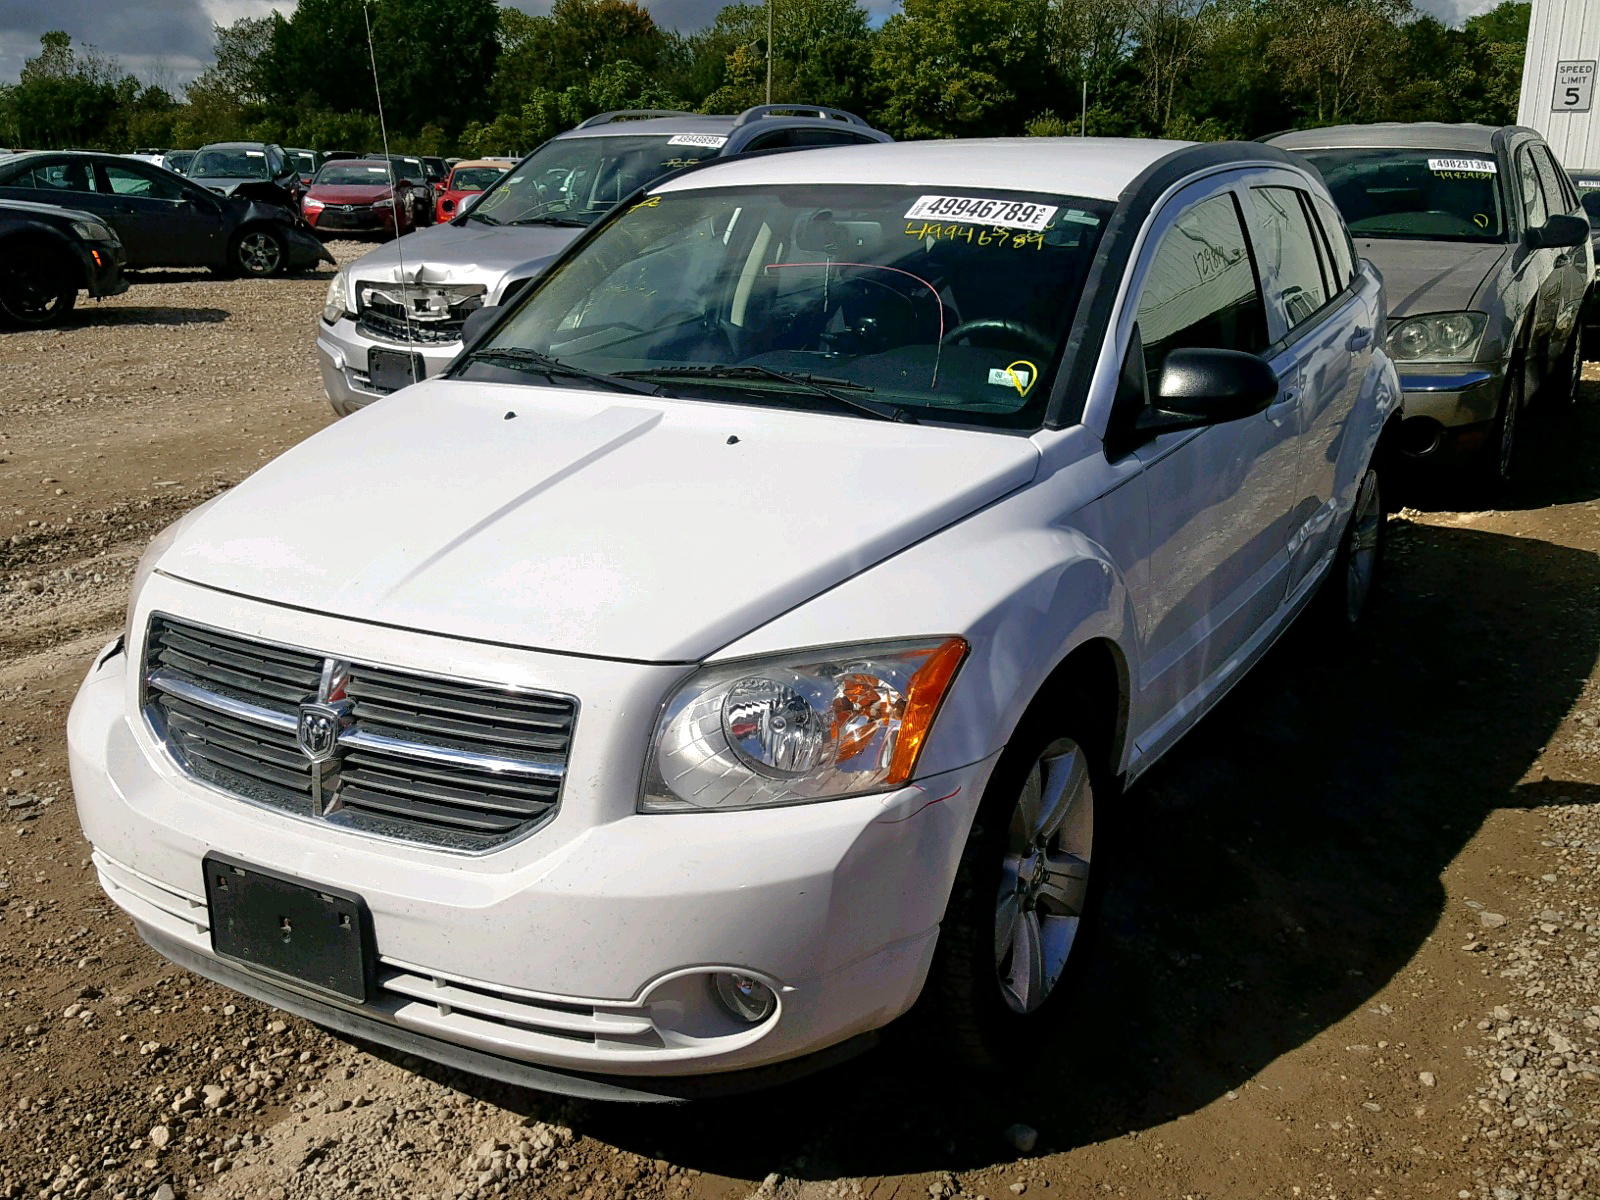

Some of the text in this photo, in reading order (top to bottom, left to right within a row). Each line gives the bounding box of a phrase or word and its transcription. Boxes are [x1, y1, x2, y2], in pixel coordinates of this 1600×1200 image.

[1560, 65, 1593, 74] SPEED
[1561, 76, 1587, 85] LIMIT
[1564, 87, 1580, 106] 5
[1436, 159, 1487, 170] 49829139
[927, 197, 1037, 224] 49946789
